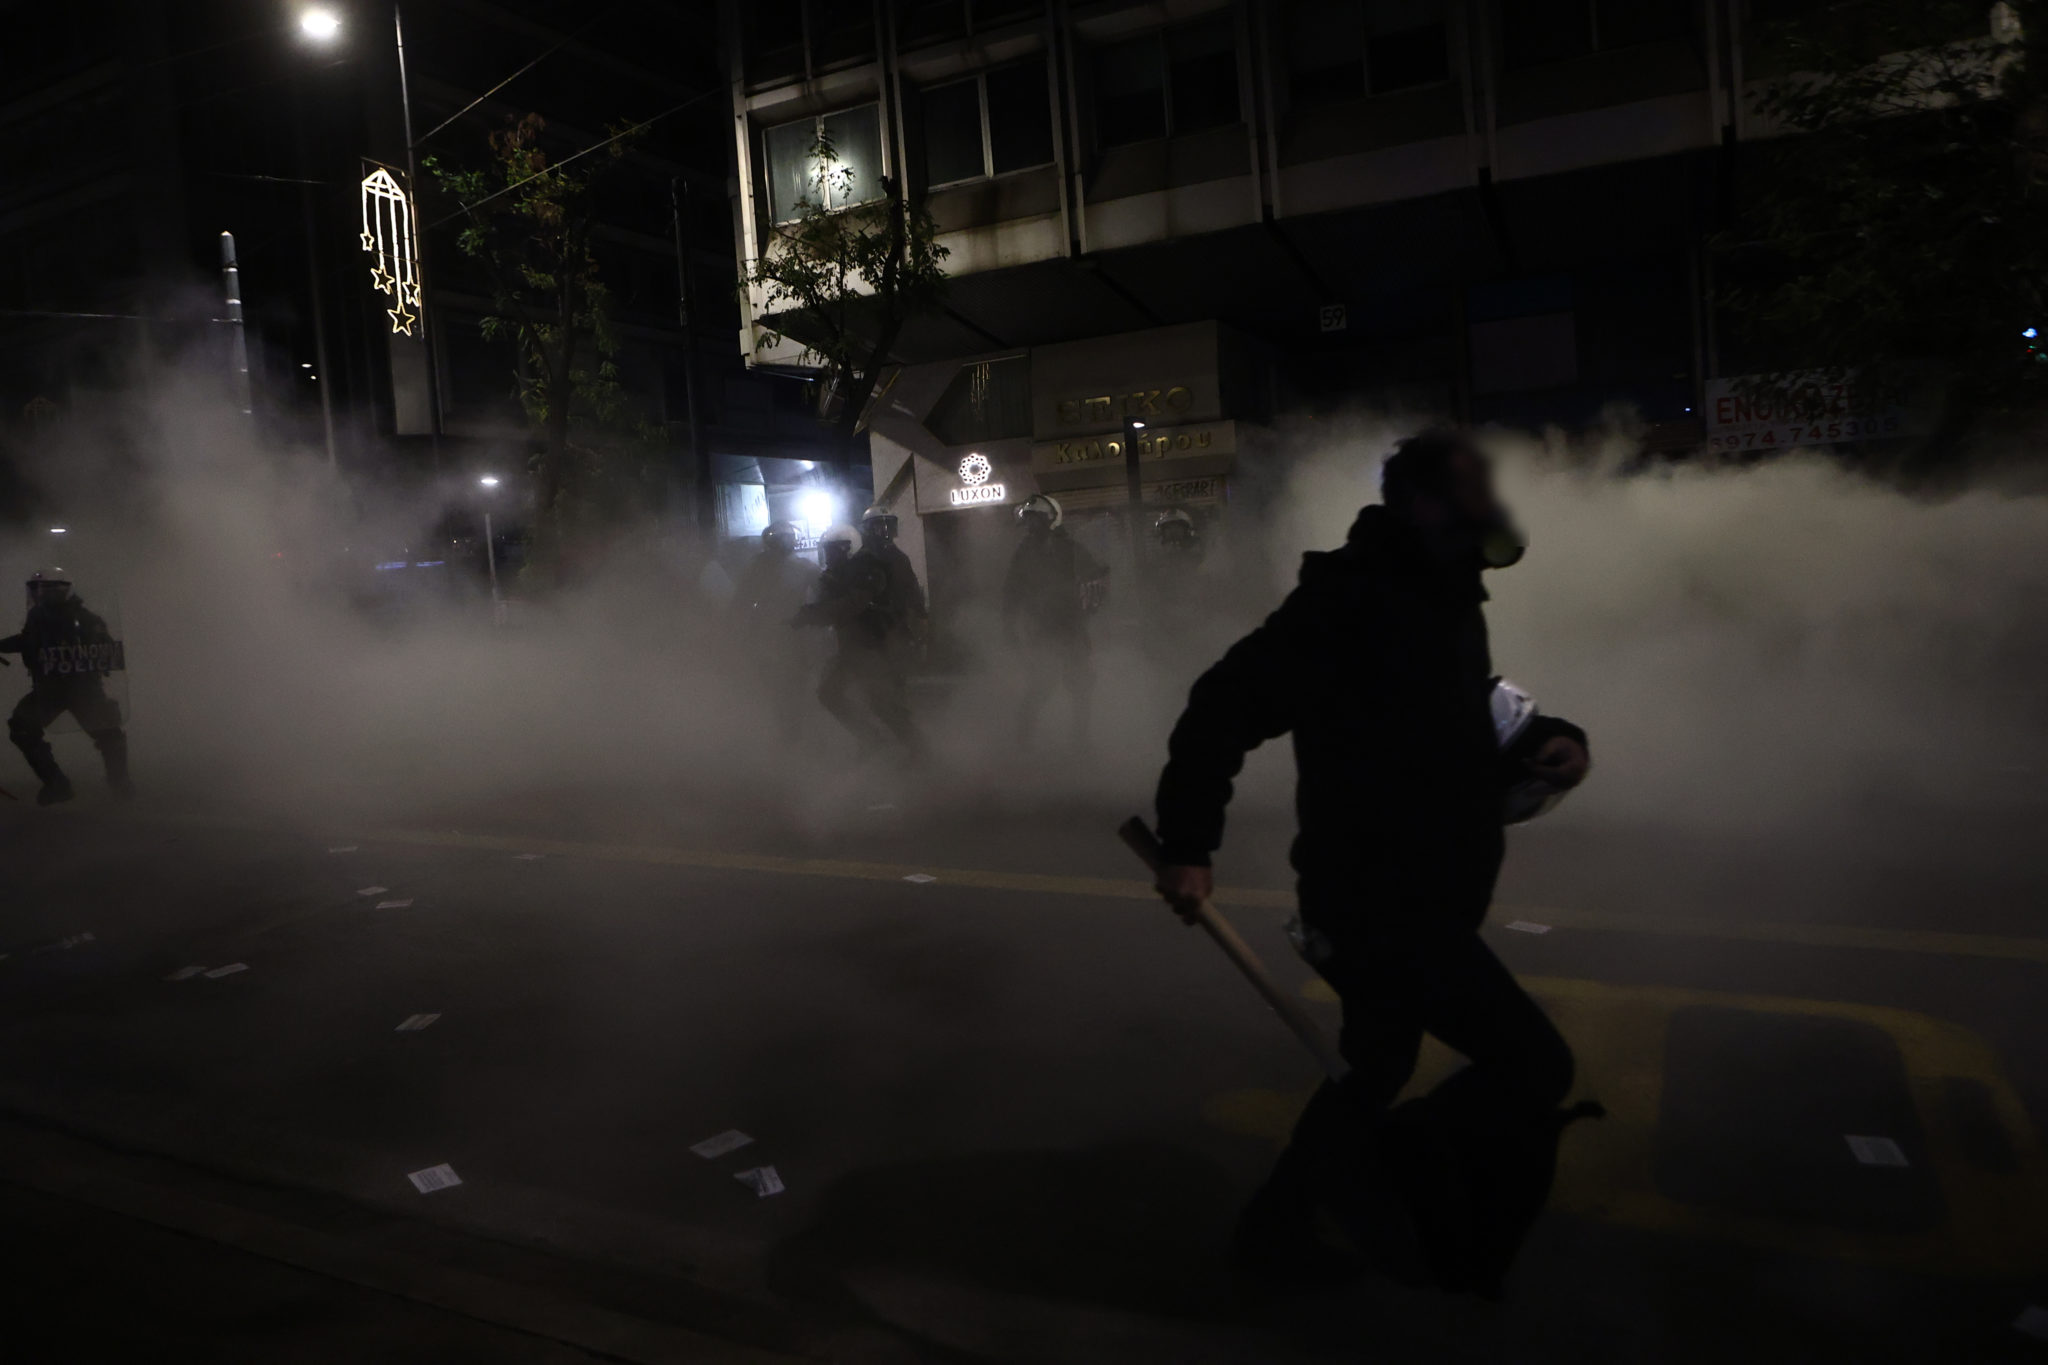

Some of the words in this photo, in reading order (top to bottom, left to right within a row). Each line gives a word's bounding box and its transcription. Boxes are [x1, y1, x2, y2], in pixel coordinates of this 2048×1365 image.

[1323, 307, 1343, 327] 59
[1056, 431, 1212, 464] Καλοήρου
[951, 485, 1004, 504] LUXON
